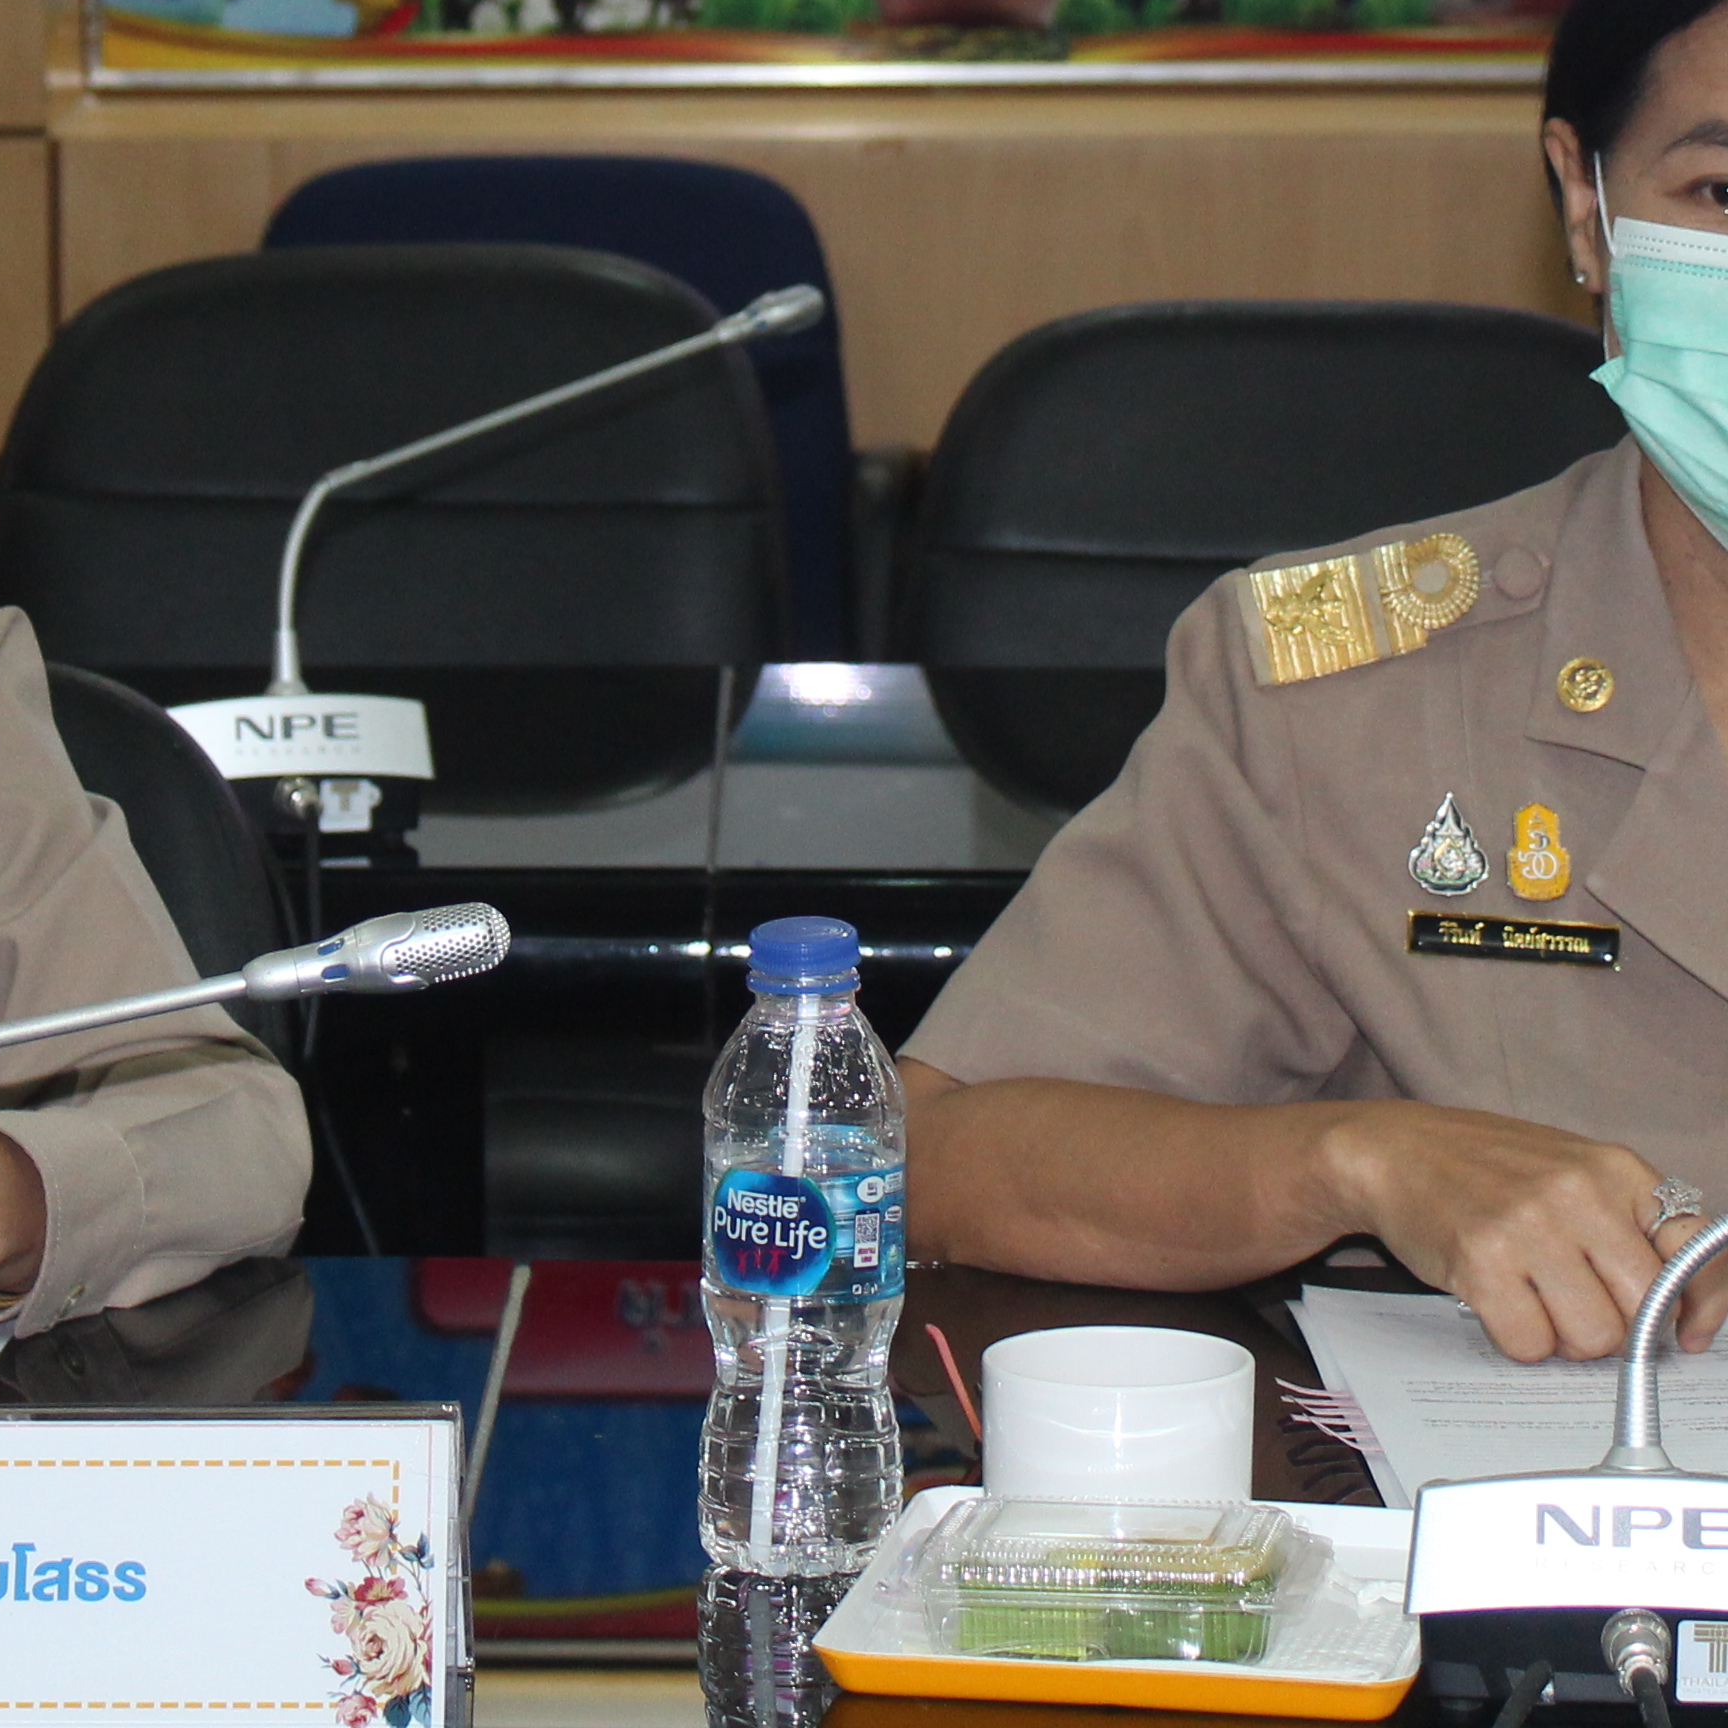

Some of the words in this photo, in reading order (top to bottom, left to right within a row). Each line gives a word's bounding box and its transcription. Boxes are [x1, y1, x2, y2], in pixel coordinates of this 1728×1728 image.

[235, 711, 360, 742] NPE
[714, 1206, 769, 1245] Pure
[775, 1219, 827, 1260] Life
